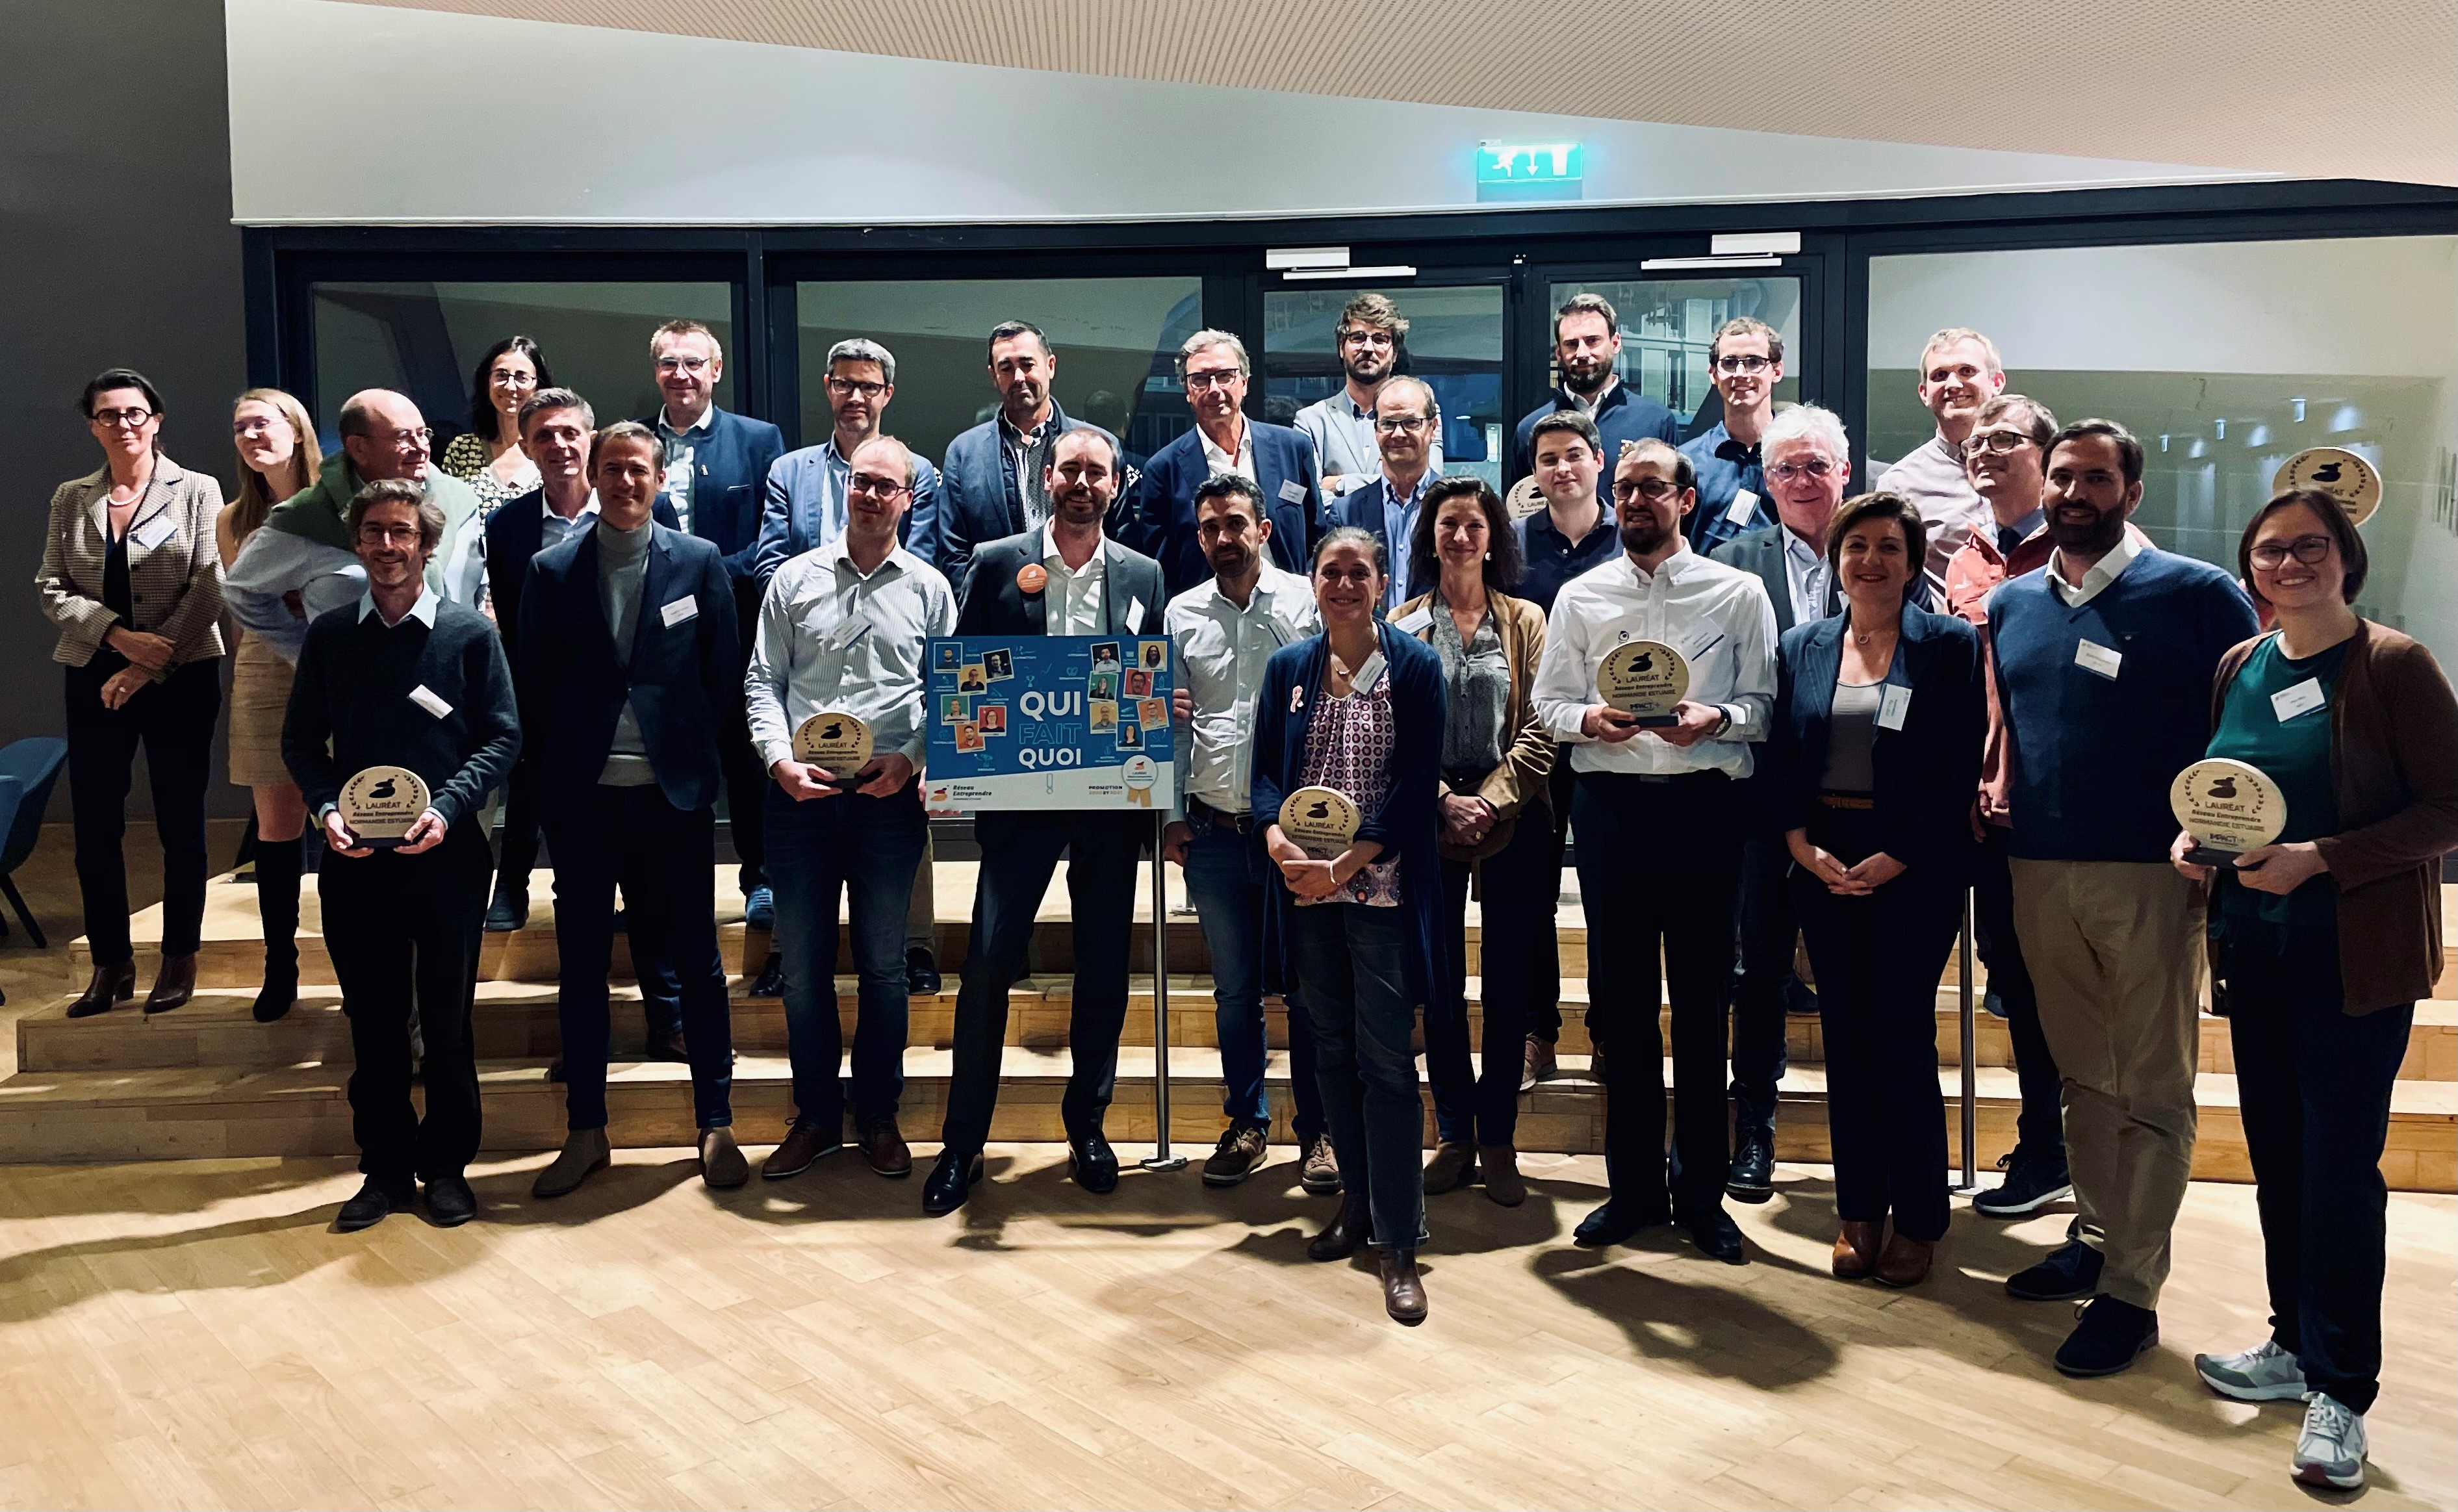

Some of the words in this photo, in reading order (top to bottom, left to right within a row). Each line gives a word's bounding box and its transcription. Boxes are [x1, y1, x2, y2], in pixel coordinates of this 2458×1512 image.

[1019, 691, 1081, 721] QUI
[1019, 723, 1082, 745] FAIT
[1019, 748, 1081, 769] QUOI
[366, 801, 401, 810] LAURÉAT
